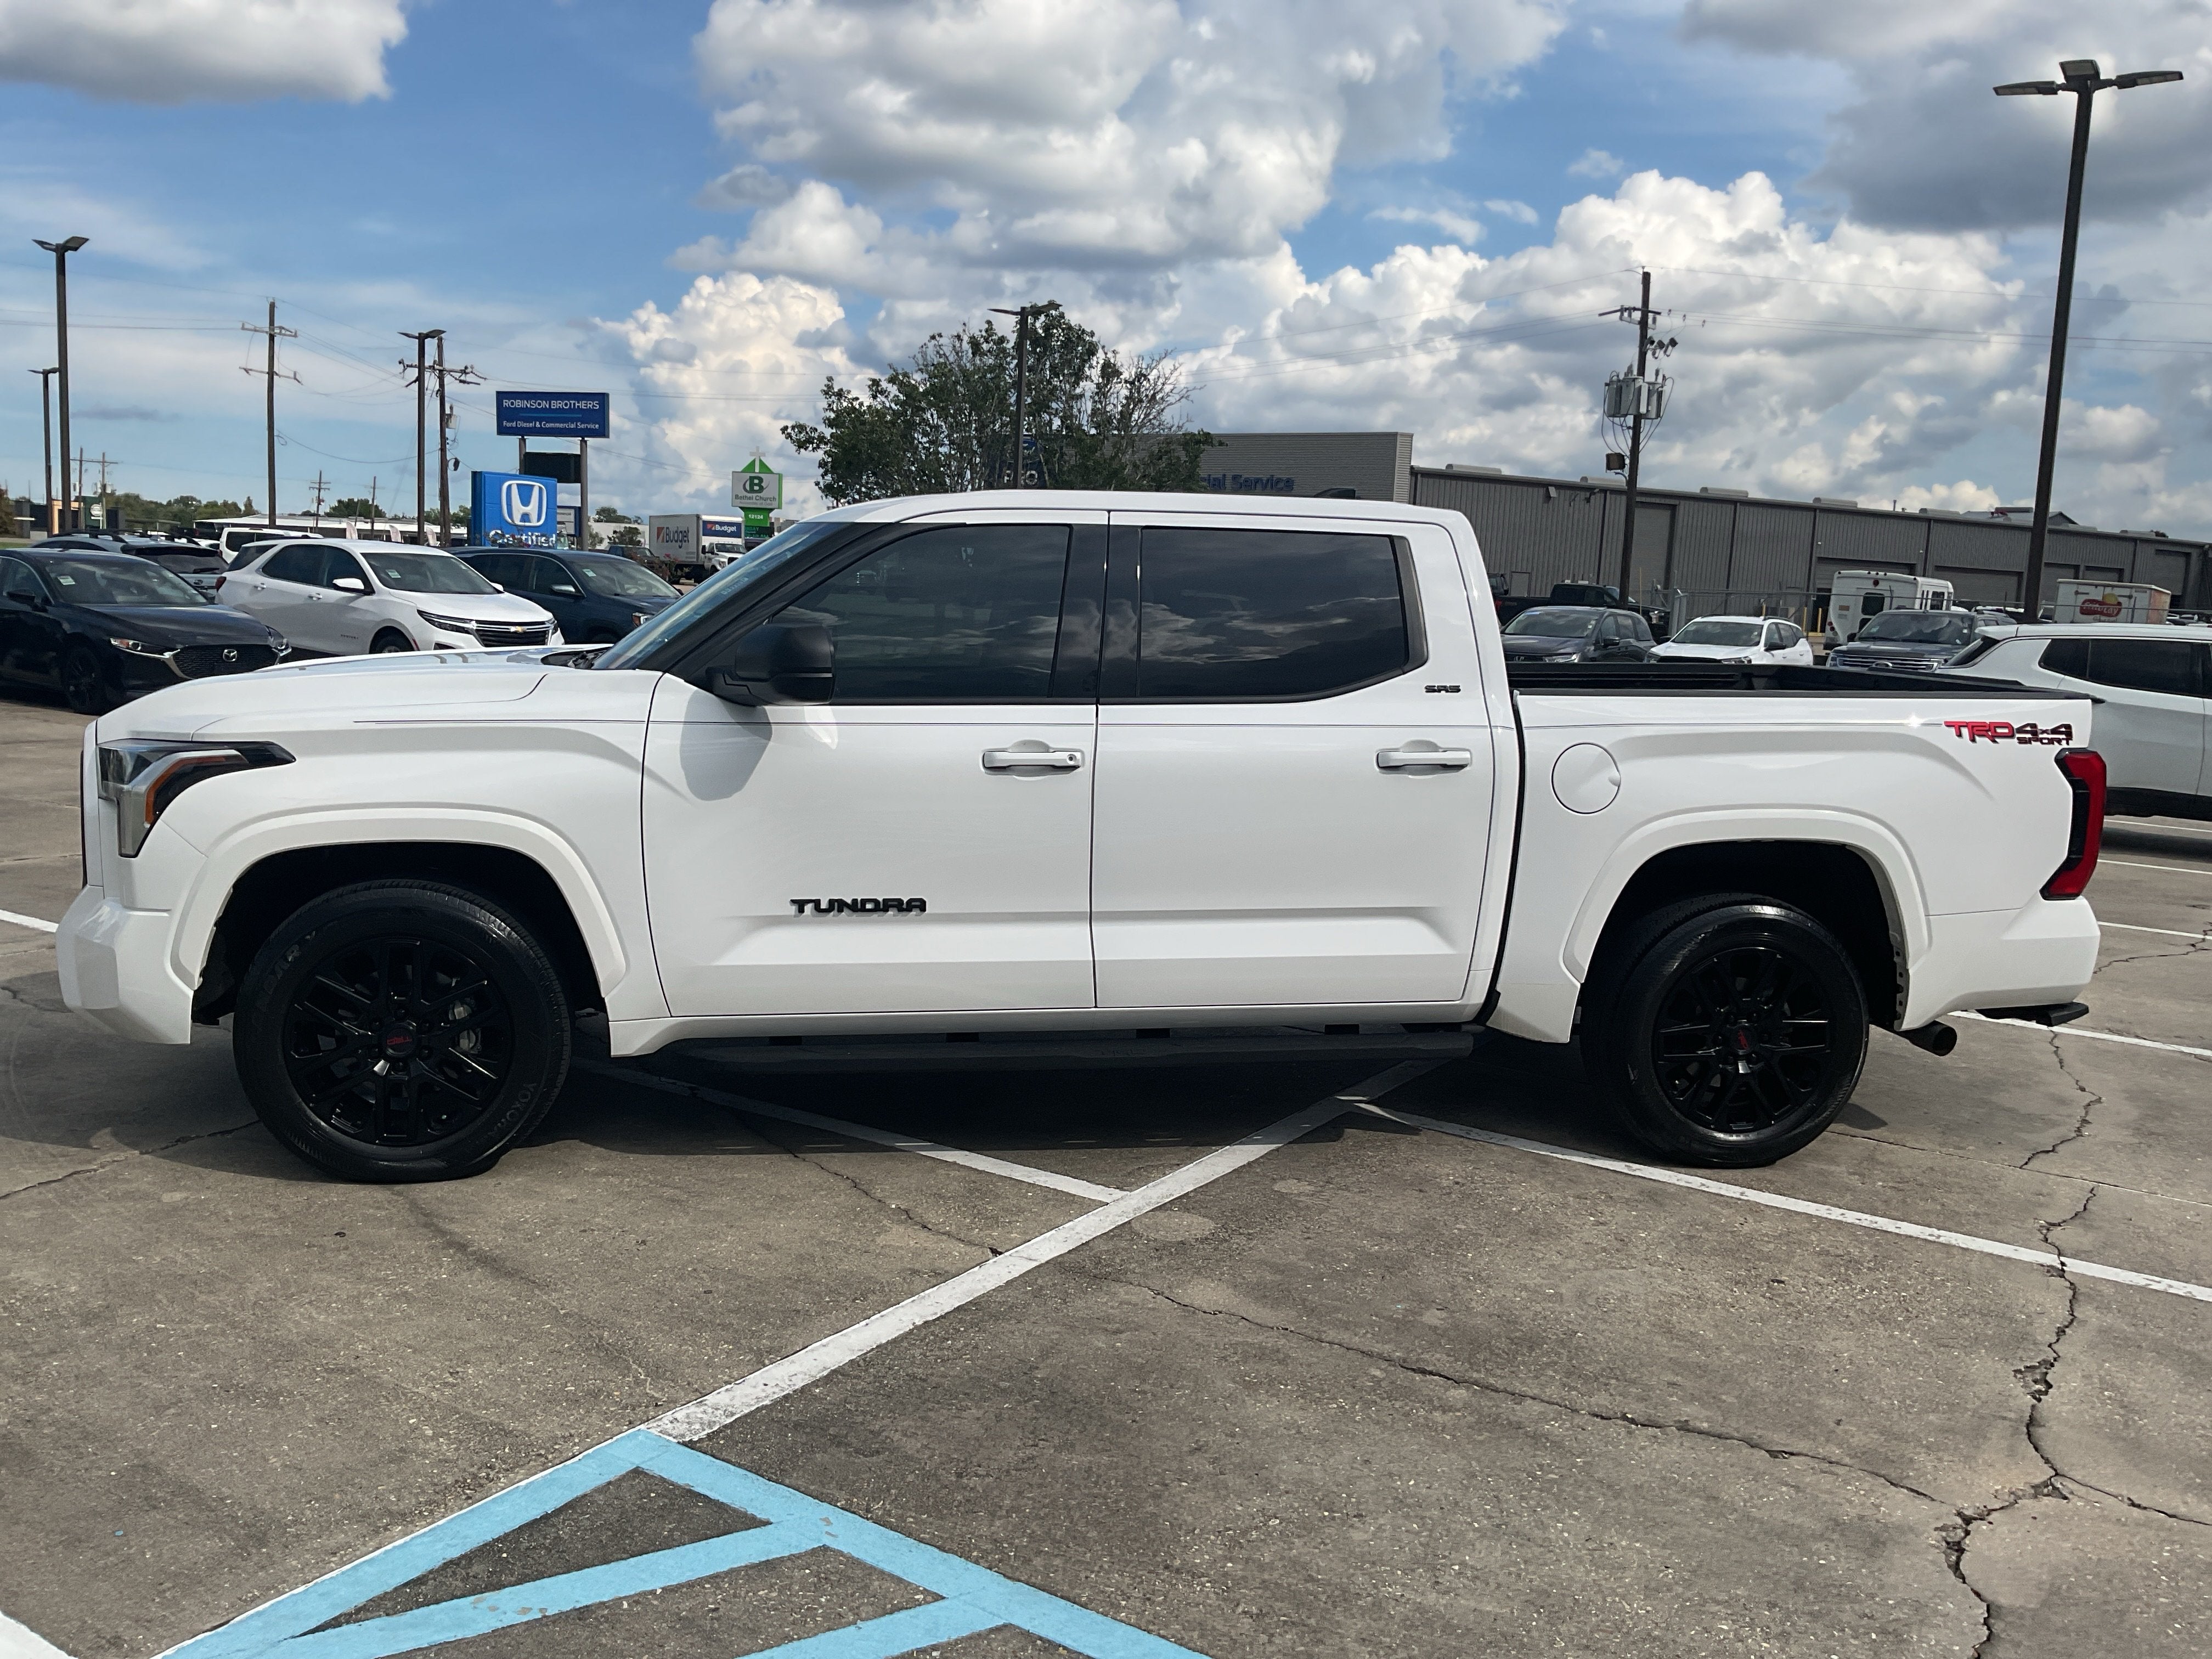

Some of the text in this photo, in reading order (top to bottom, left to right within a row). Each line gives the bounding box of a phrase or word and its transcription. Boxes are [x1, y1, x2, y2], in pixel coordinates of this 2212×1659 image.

[503, 400, 599, 409] ROBINSON BROTHERS
[1232, 475, 1294, 491] Service
[715, 524, 736, 533] Budget
[665, 527, 690, 549] Budget
[1944, 721, 2073, 744] TRD 4x4
[2016, 737, 2073, 745] SPORT
[790, 898, 927, 913] TUNDRA
